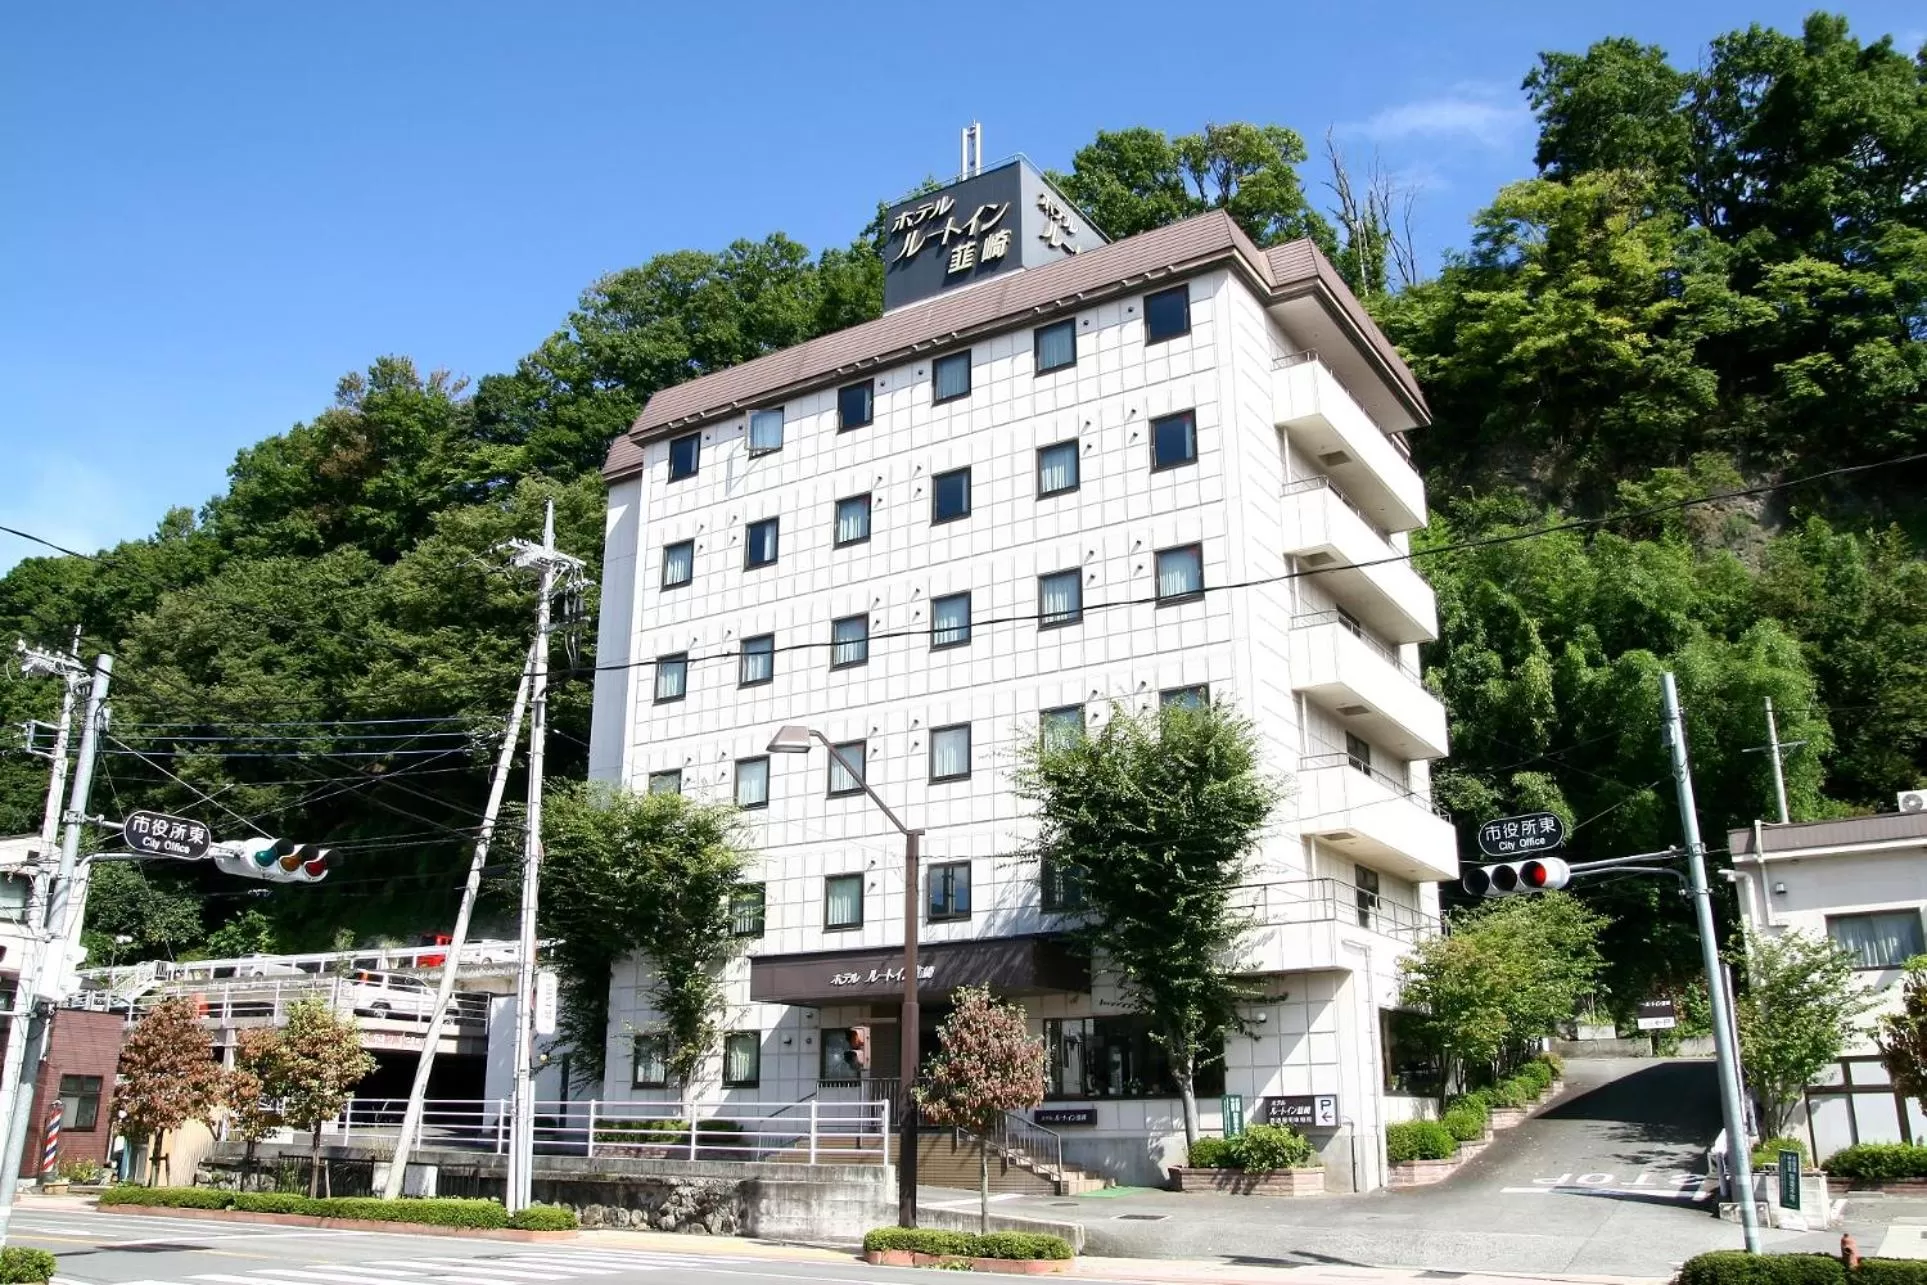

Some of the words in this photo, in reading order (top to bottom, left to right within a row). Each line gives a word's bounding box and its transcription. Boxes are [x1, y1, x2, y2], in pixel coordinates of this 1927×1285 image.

[891, 196, 955, 233] ホテル
[891, 202, 1010, 262] ルートイン
[948, 229, 1012, 273] 韮崎
[133, 815, 205, 845] 市役所東
[1484, 817, 1556, 841] 市役所東
[142, 836, 160, 850] City
[164, 840, 191, 854] Office
[1498, 841, 1515, 851] City
[1519, 837, 1545, 848] Office
[830, 972, 860, 985] ホテル
[1320, 1099, 1331, 1111] P
